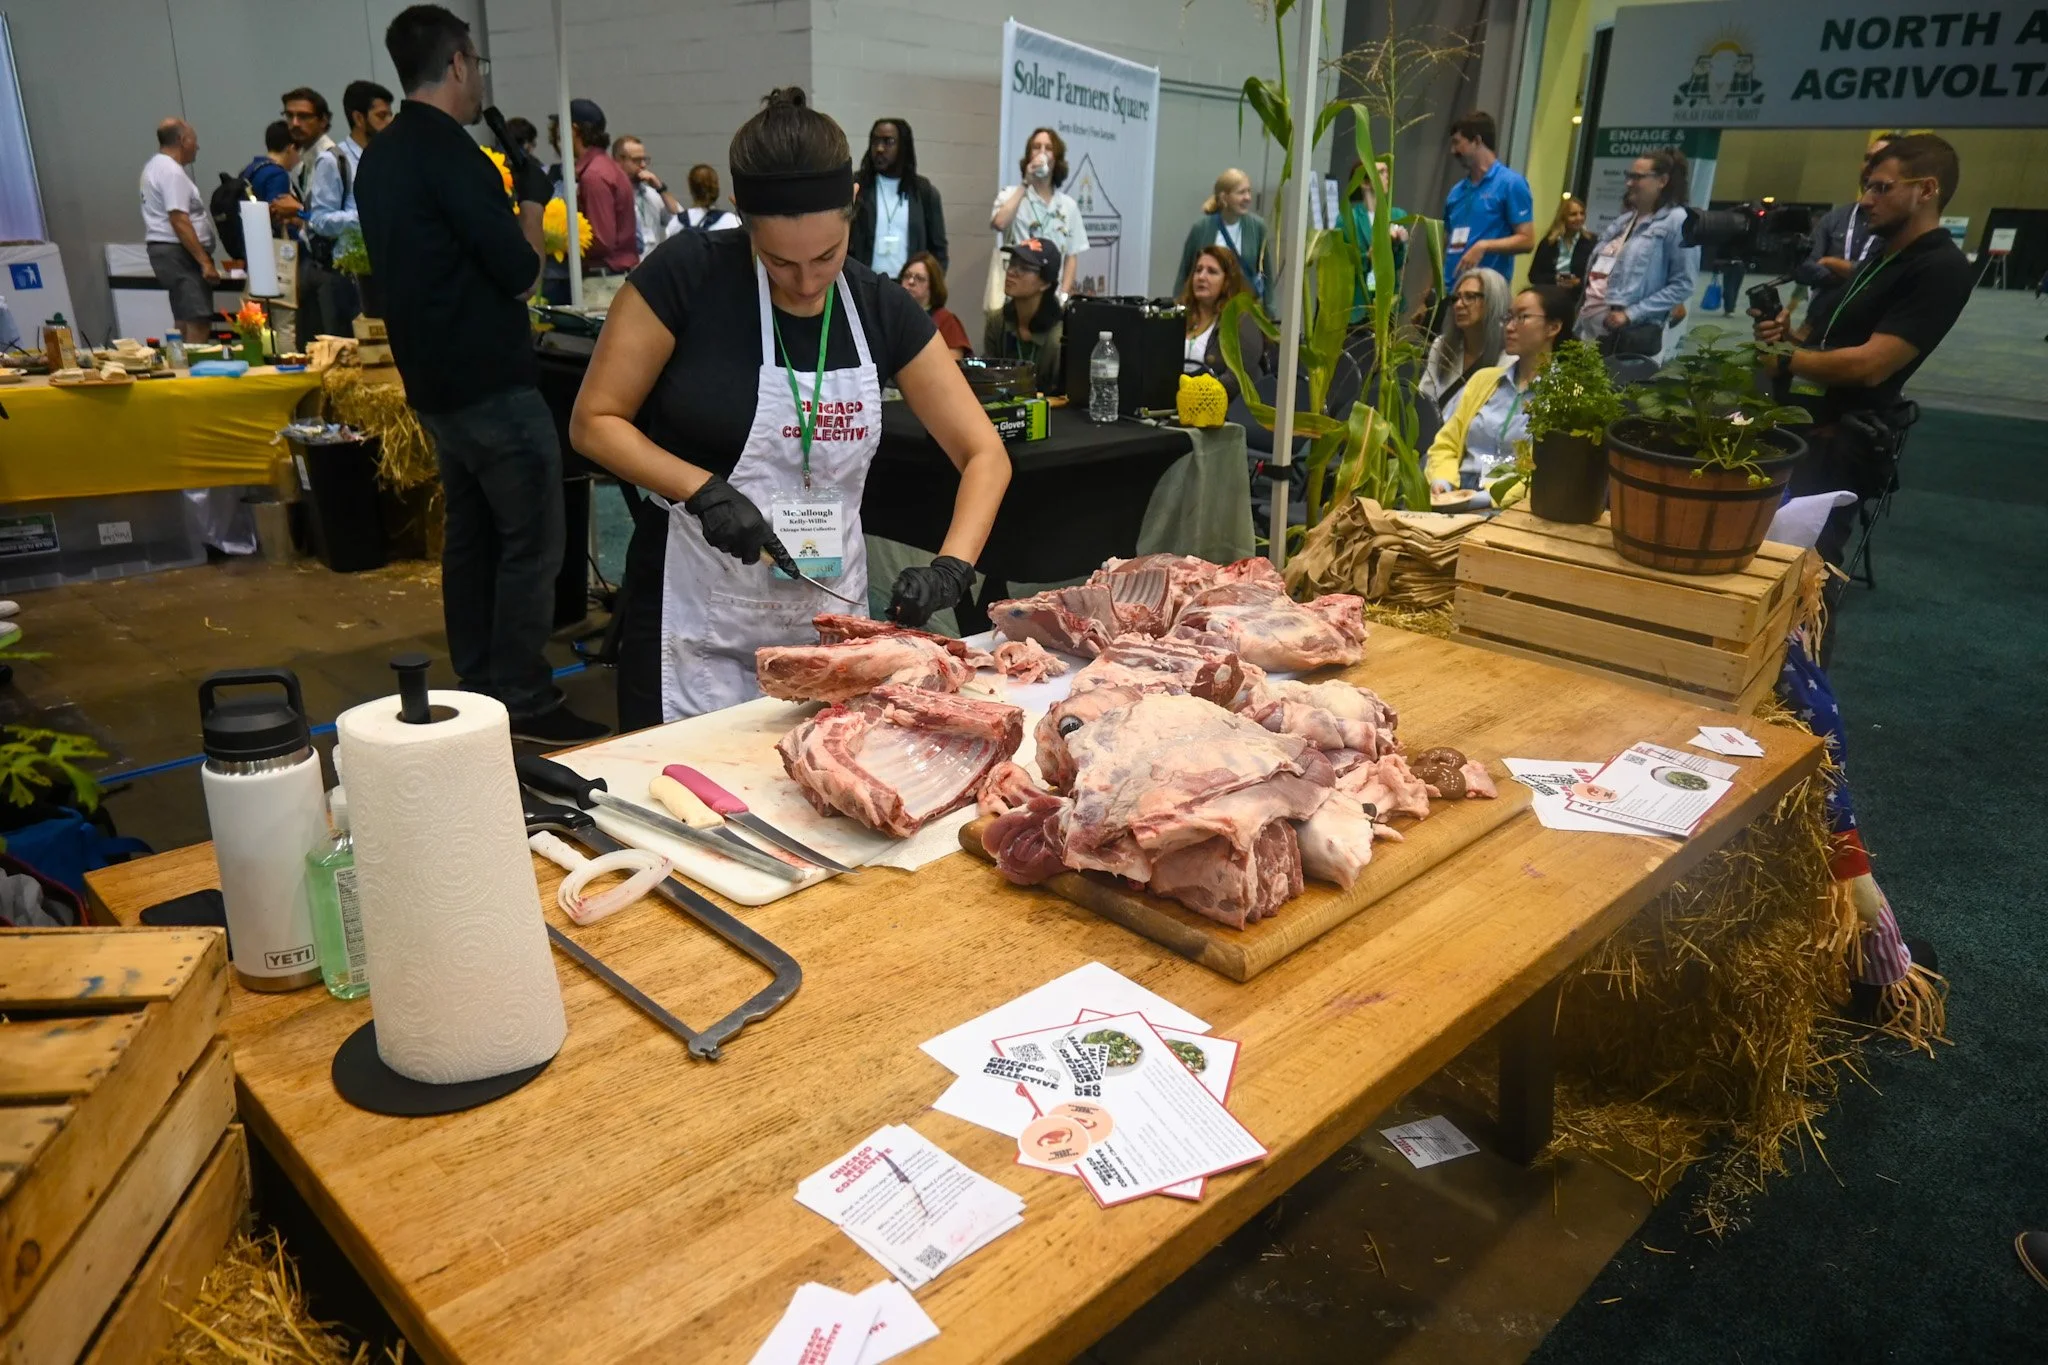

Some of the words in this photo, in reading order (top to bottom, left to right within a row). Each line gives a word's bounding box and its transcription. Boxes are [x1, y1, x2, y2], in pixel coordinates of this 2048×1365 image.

[1820, 11, 2001, 51] NORTH
[2014, 9, 2048, 45] A
[1012, 59, 1054, 100] Solar
[1056, 72, 1110, 113] Farmers
[1112, 86, 1149, 124] Square
[1609, 130, 1670, 140] ENGAGE
[1674, 129, 1684, 140] &
[808, 413, 854, 428] MEAT
[1000, 420, 1026, 430] Gloves
[782, 426, 868, 440] COLECTIVE
[269, 948, 310, 966] YETI
[986, 1062, 1024, 1073] MEAT
[990, 1057, 1044, 1072] CHICAGO
[1067, 1036, 1102, 1081] COLLECTIVE
[983, 1068, 1060, 1090] COLLECTIVE
[1074, 1058, 1094, 1082] MEAT
[830, 1146, 872, 1180] CHICAGO
[836, 1148, 893, 1193] COLLECTIVE
[843, 1154, 872, 1178] MEAT
